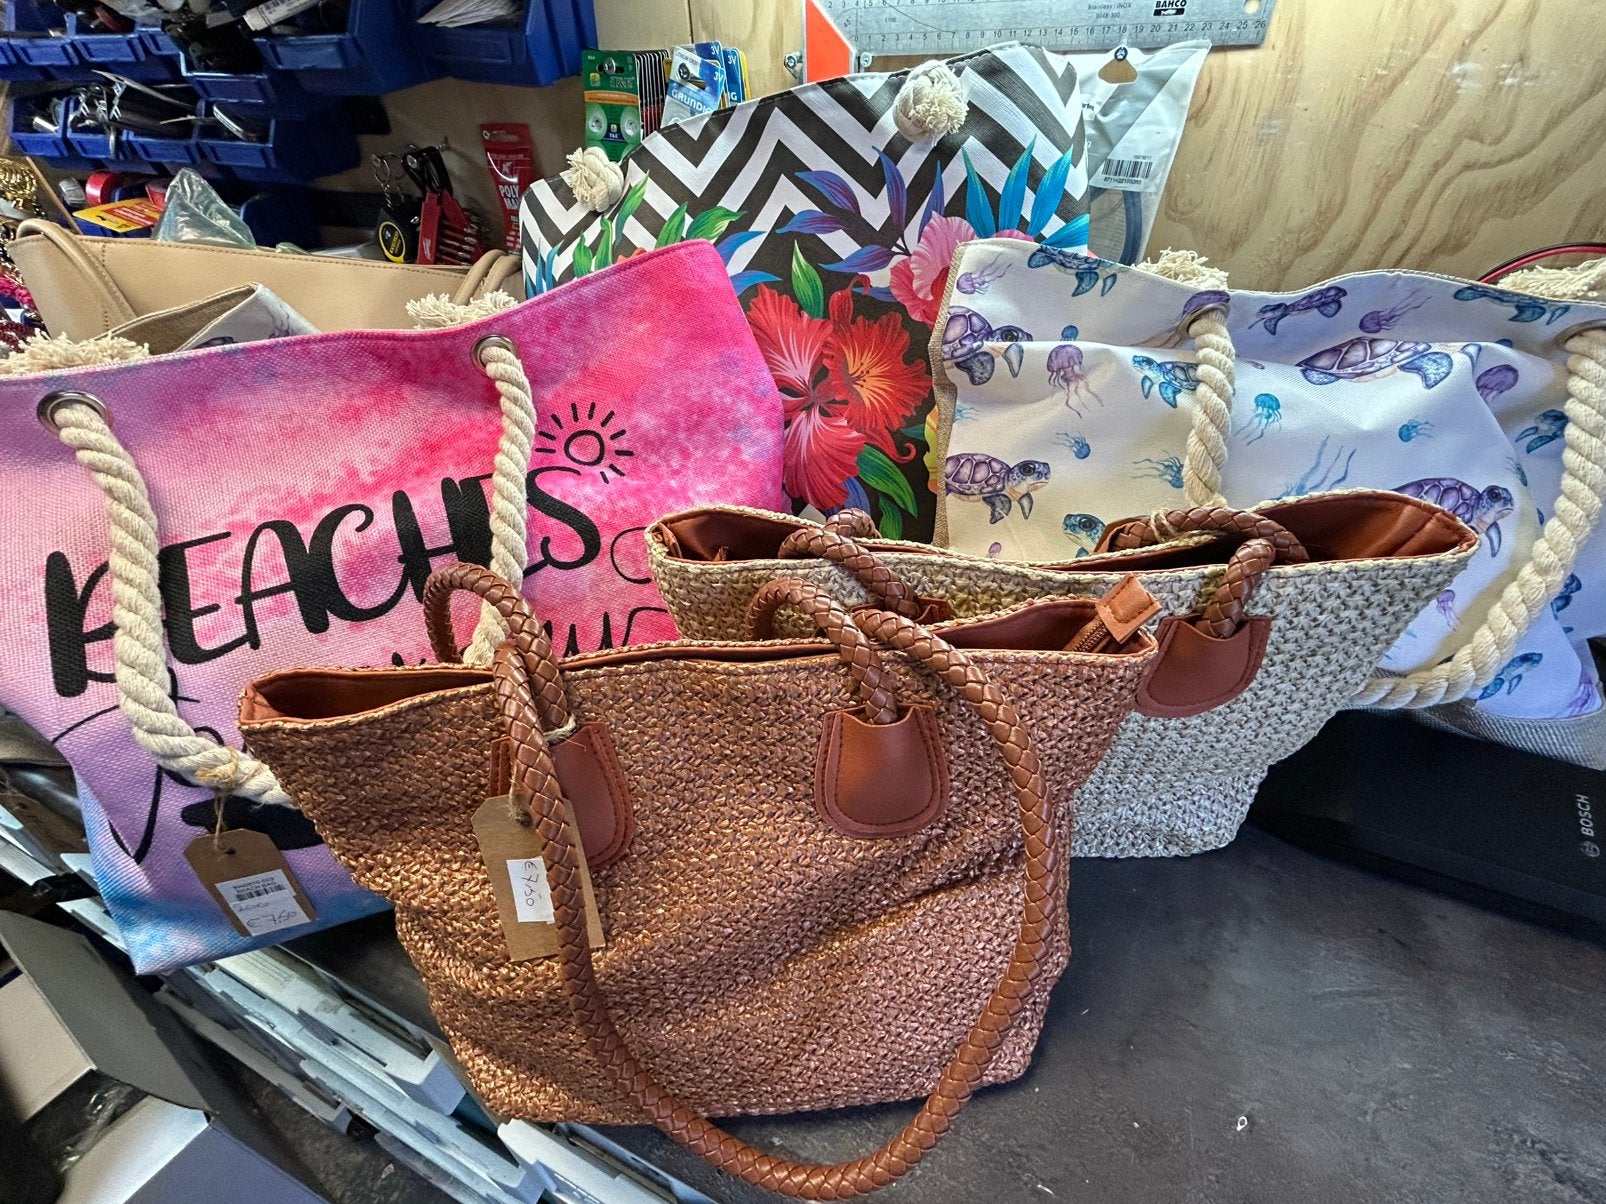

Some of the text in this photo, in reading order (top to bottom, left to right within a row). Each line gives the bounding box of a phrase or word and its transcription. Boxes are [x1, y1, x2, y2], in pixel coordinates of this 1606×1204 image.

[1155, 0, 1187, 8] BAHCO
[1118, 26, 1127, 34] 18
[1135, 25, 1144, 33] 19
[1150, 24, 1160, 32] 20
[1184, 24, 1196, 32] 22
[1202, 22, 1212, 30] 23
[1218, 22, 1230, 30] 24
[1236, 21, 1248, 30] 25
[1254, 20, 1266, 28] 26
[710, 46, 720, 55] 3V
[728, 55, 736, 64] 3V
[499, 184, 519, 198] POLY
[1576, 794, 1594, 837] BOSCH
